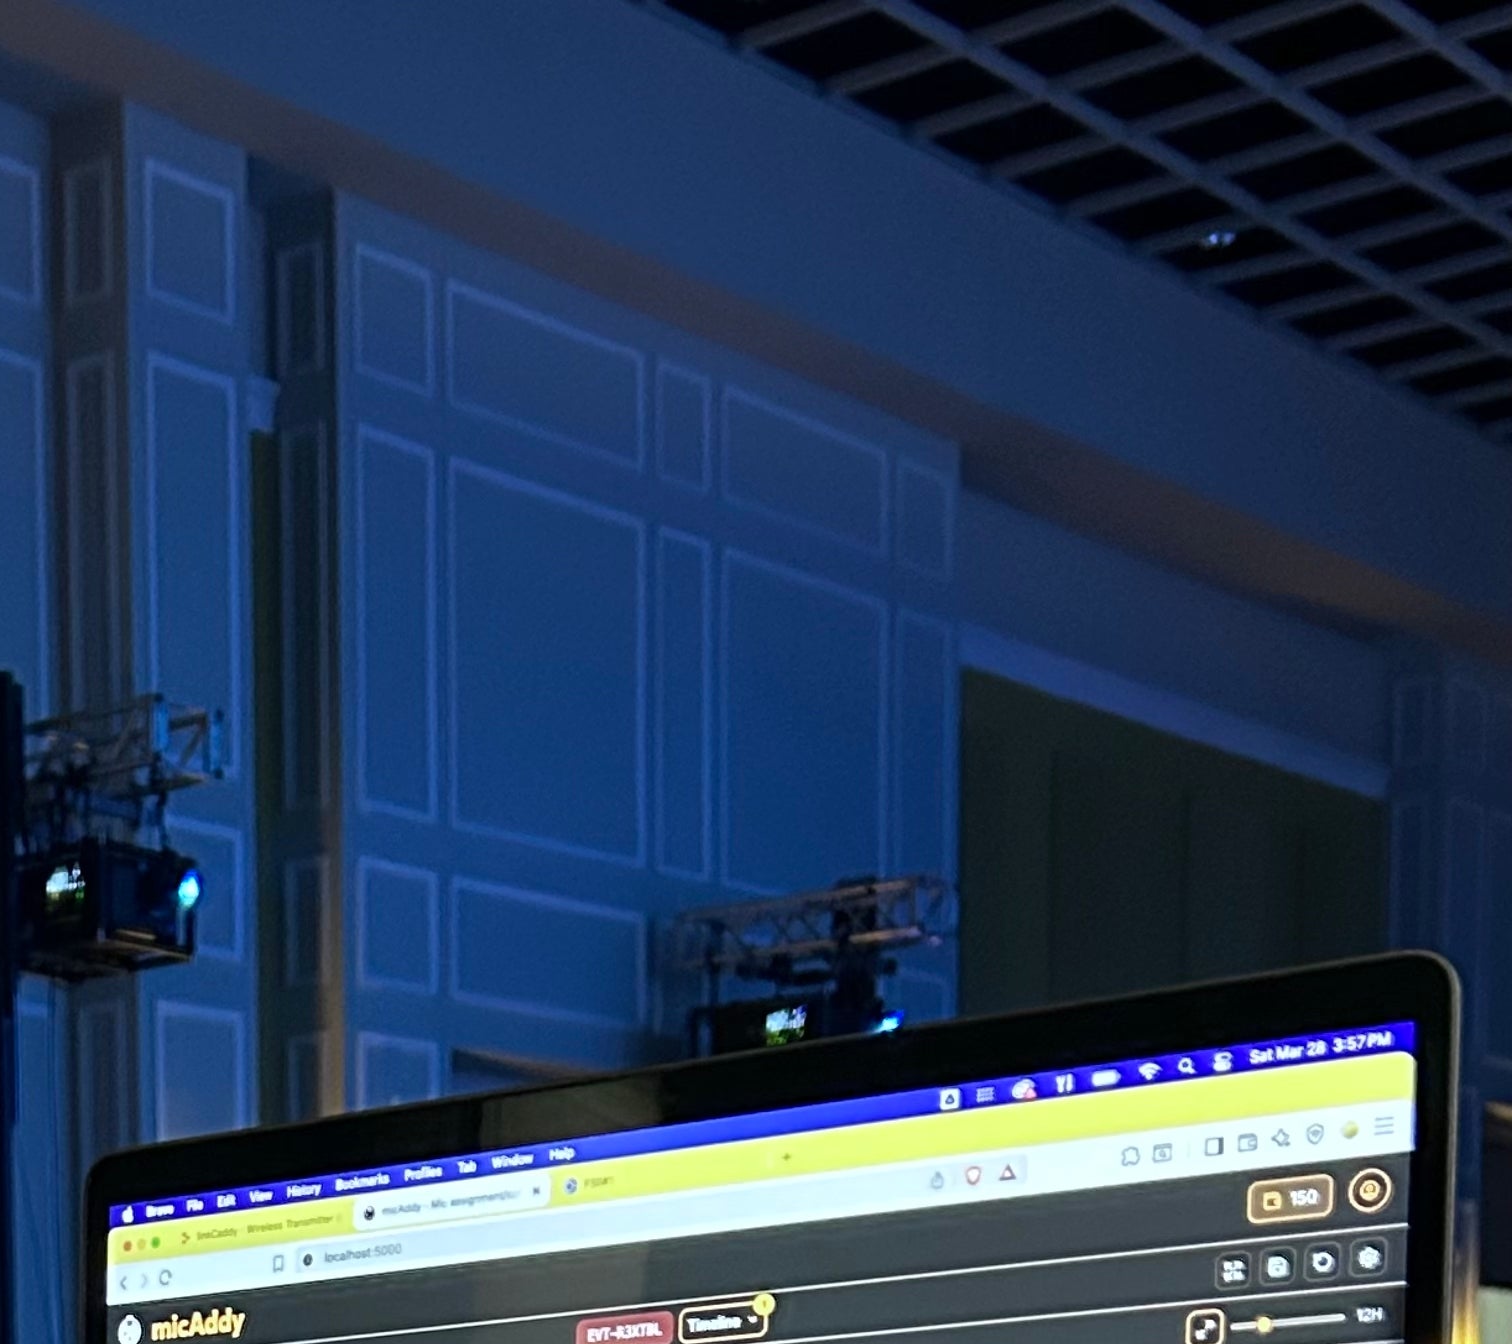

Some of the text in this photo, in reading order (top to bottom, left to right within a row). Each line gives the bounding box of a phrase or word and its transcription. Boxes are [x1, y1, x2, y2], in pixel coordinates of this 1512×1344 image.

[1249, 1031, 1392, 1064] Sat Mar 28 3:57 PM
[186, 1199, 204, 1211] File
[217, 1194, 236, 1207] Edit
[249, 1189, 273, 1203] View
[286, 1182, 321, 1199] History
[335, 1172, 390, 1191] Bookmarks
[403, 1165, 442, 1181] Profiles
[456, 1160, 477, 1173] Tab
[491, 1153, 534, 1169] Window
[549, 1147, 576, 1161] Help
[324, 1243, 402, 1263] localhost:5000
[150, 1306, 246, 1342] micAddy
[686, 1314, 743, 1333] Timeline
